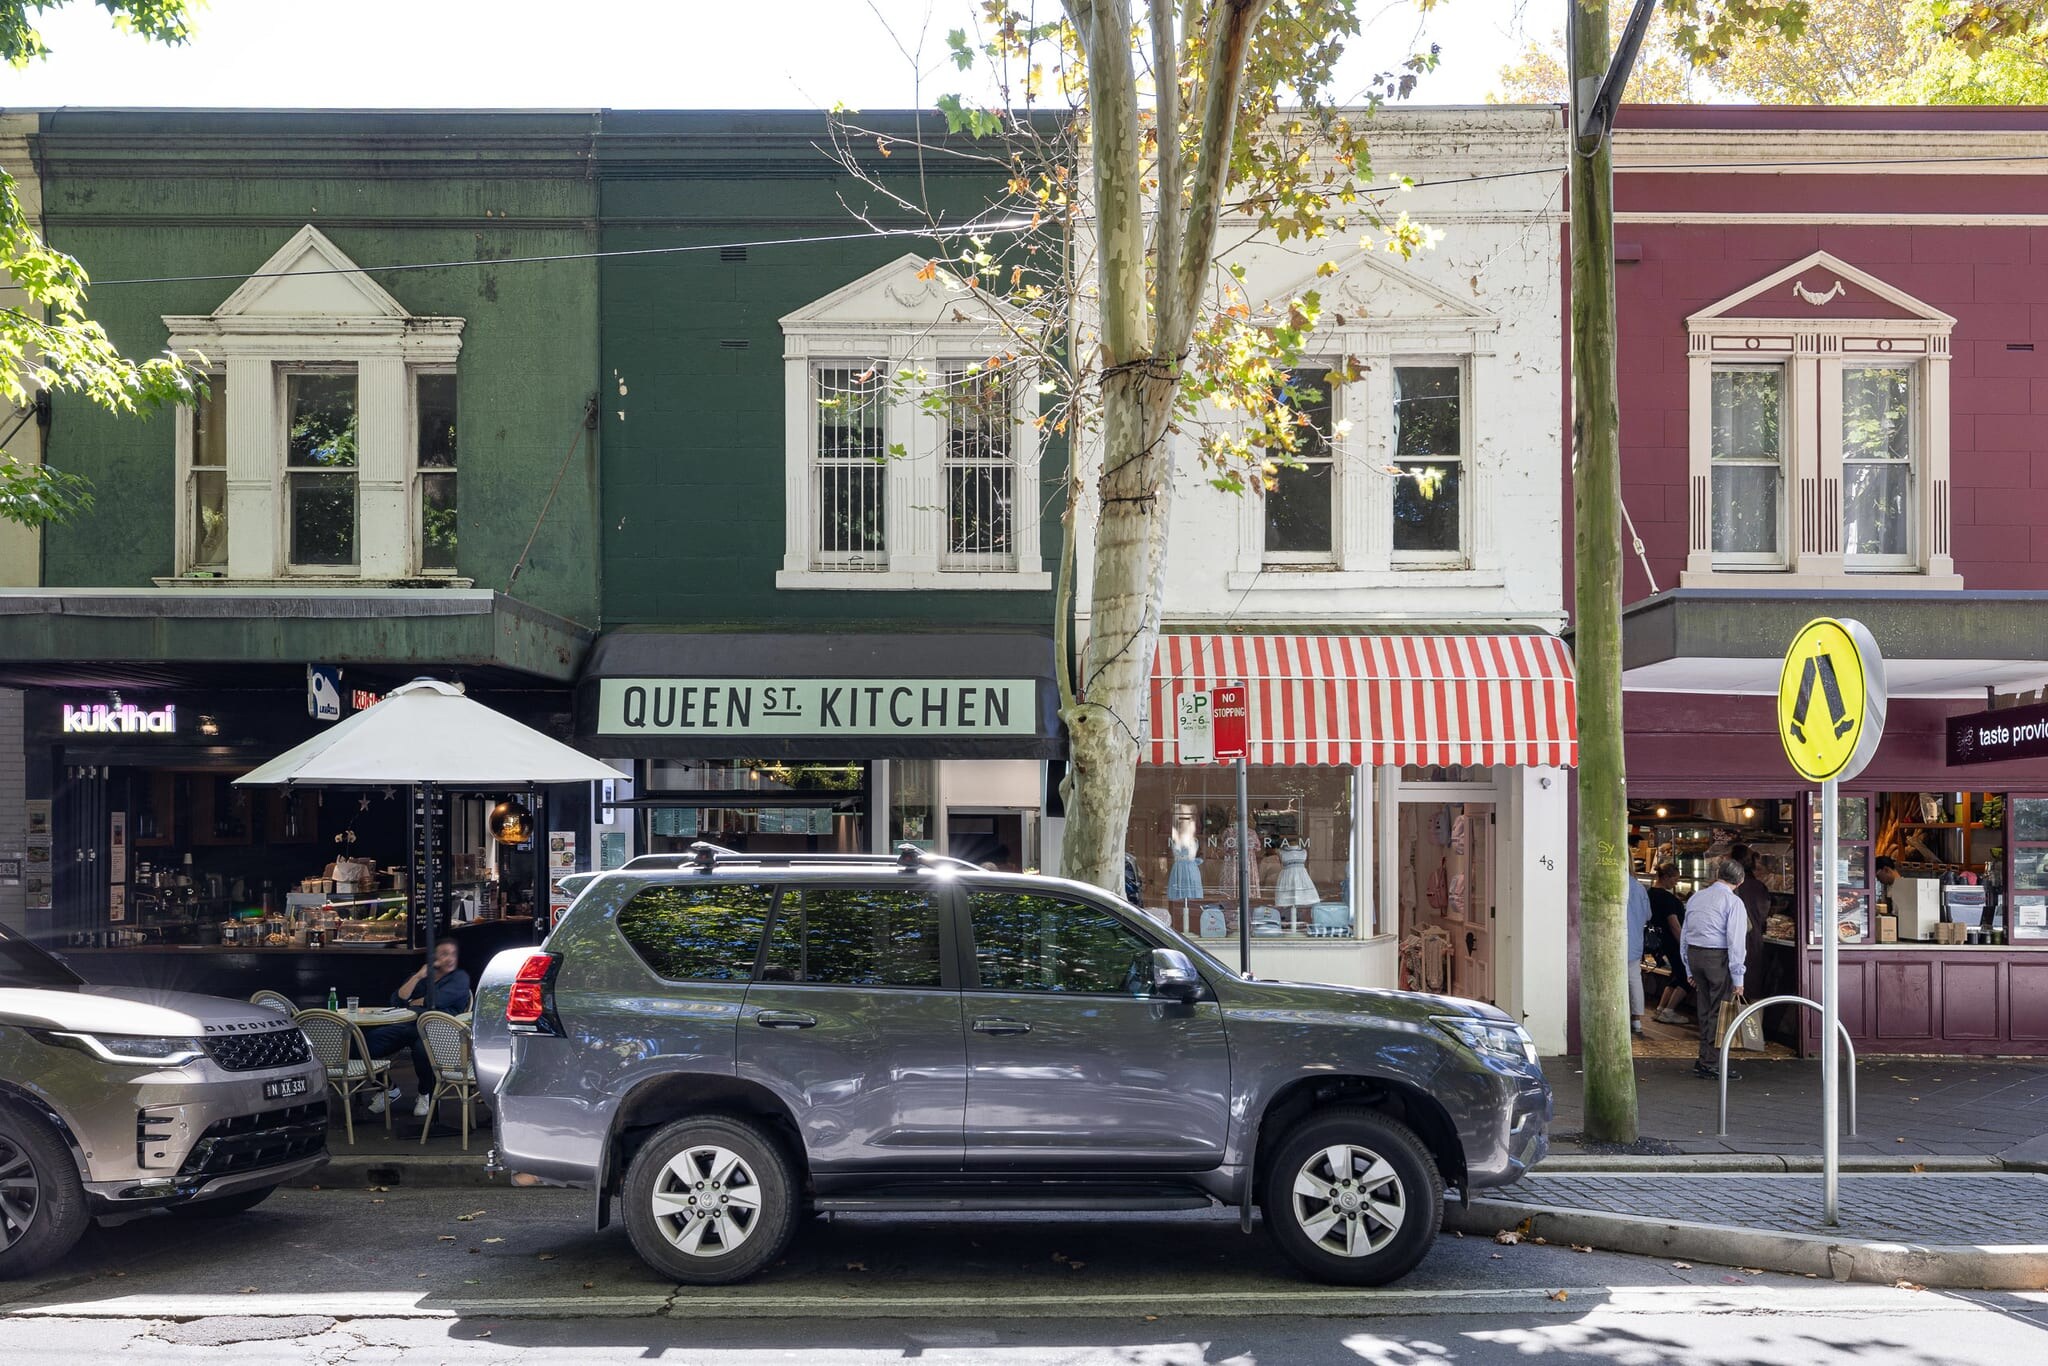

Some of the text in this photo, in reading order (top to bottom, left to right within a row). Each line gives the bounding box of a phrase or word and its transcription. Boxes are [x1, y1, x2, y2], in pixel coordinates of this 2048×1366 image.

[1221, 693, 1235, 703] NO
[623, 686, 1009, 728] QUEEN ST. KITCHEN
[1214, 706, 1245, 718] STOPPING
[1979, 725, 2009, 745] taste
[1539, 854, 1554, 871] 48
[204, 1019, 289, 1032] DISCOVERY
